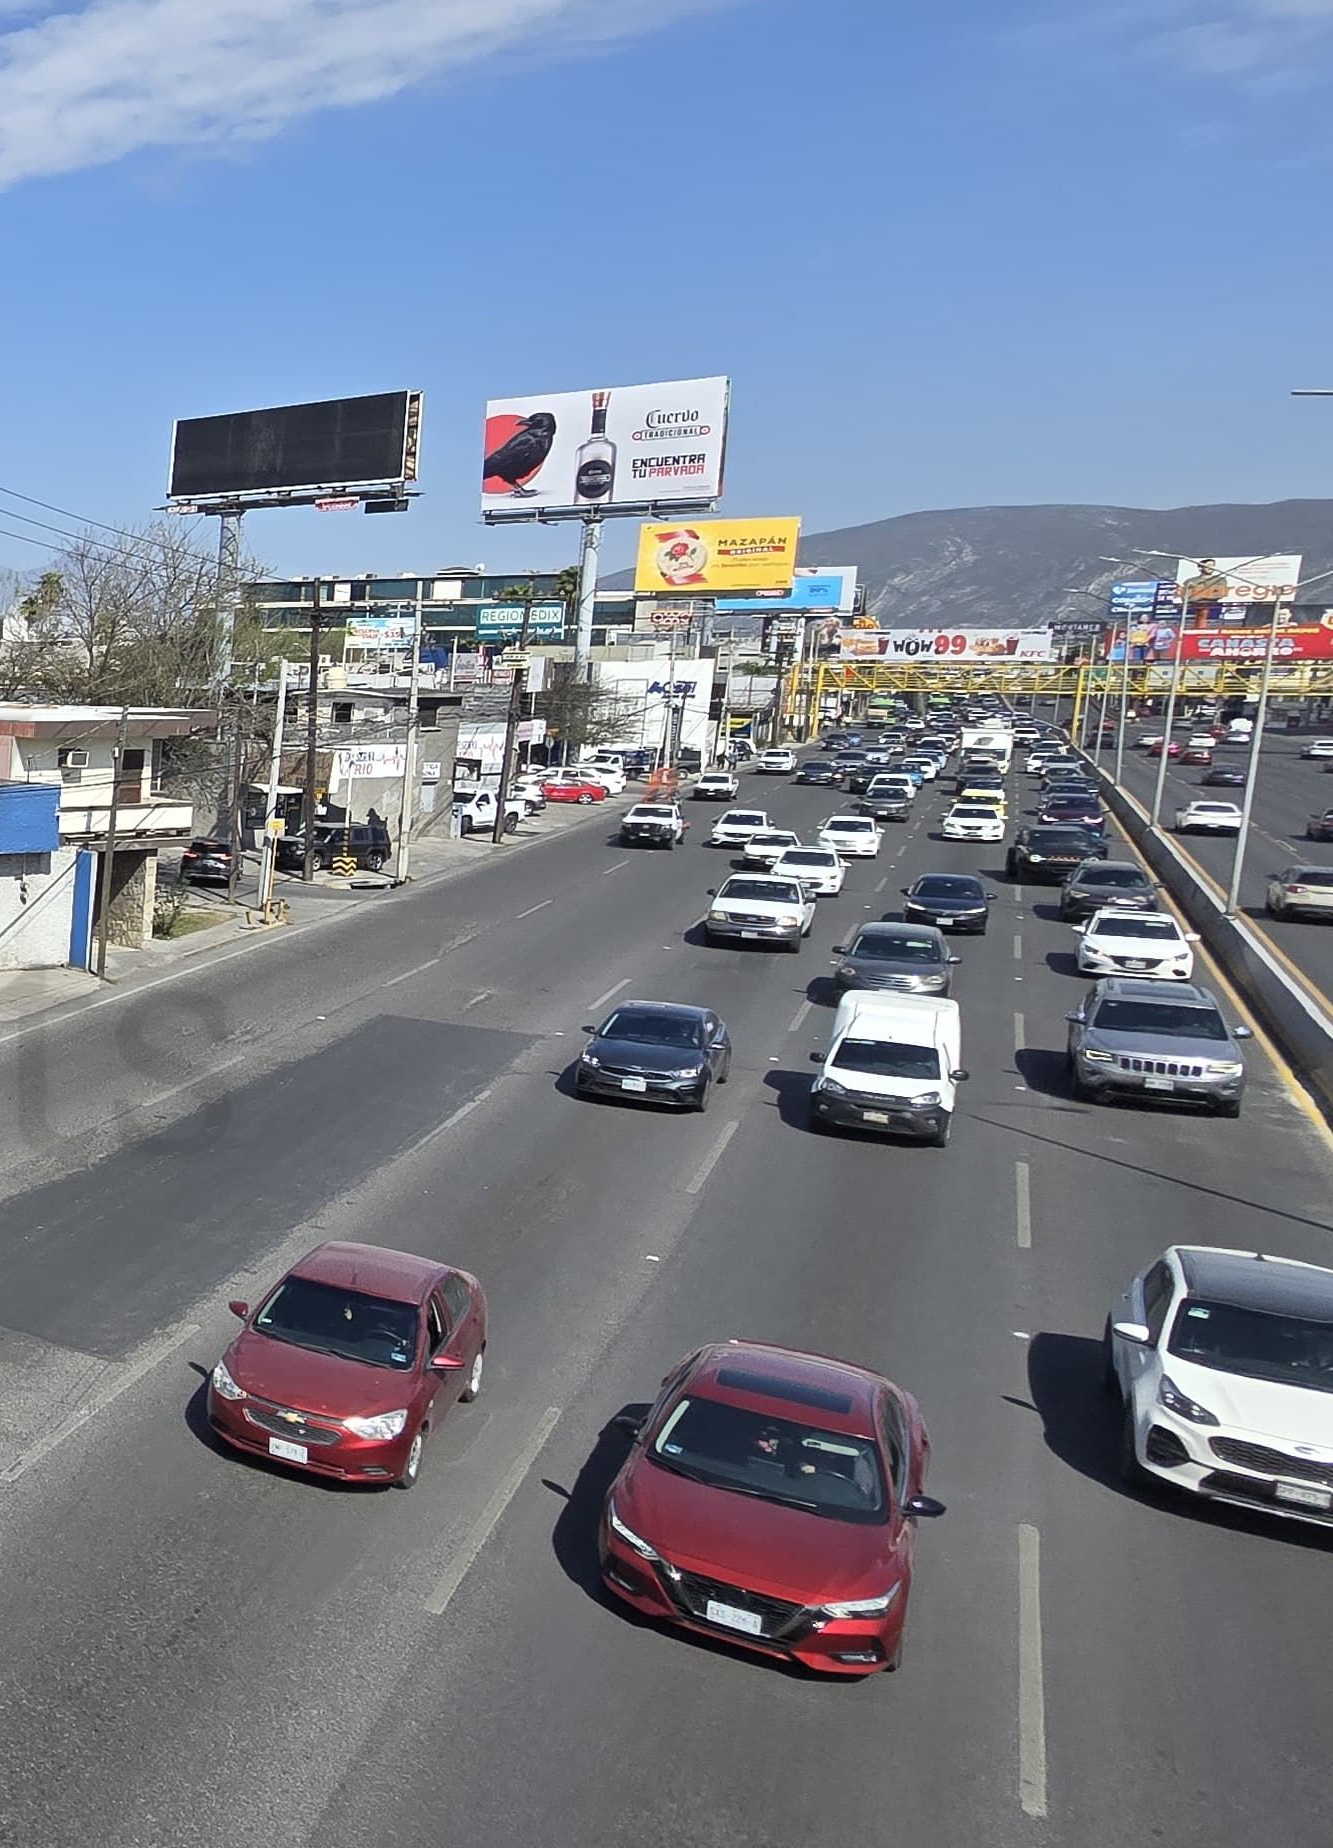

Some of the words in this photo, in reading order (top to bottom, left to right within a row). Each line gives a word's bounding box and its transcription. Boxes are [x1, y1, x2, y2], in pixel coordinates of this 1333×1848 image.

[645, 409, 700, 429] Cuervo
[643, 427, 700, 440] TRADICIONAL
[632, 453, 707, 470] ENCUENTRA
[632, 468, 648, 480] TU
[648, 464, 706, 479] PARVADA
[717, 535, 789, 548] MAZAPÁN
[480, 606, 562, 624] REGIOEDIX
[933, 634, 967, 655] 99
[1197, 637, 1295, 649] CANASTA
